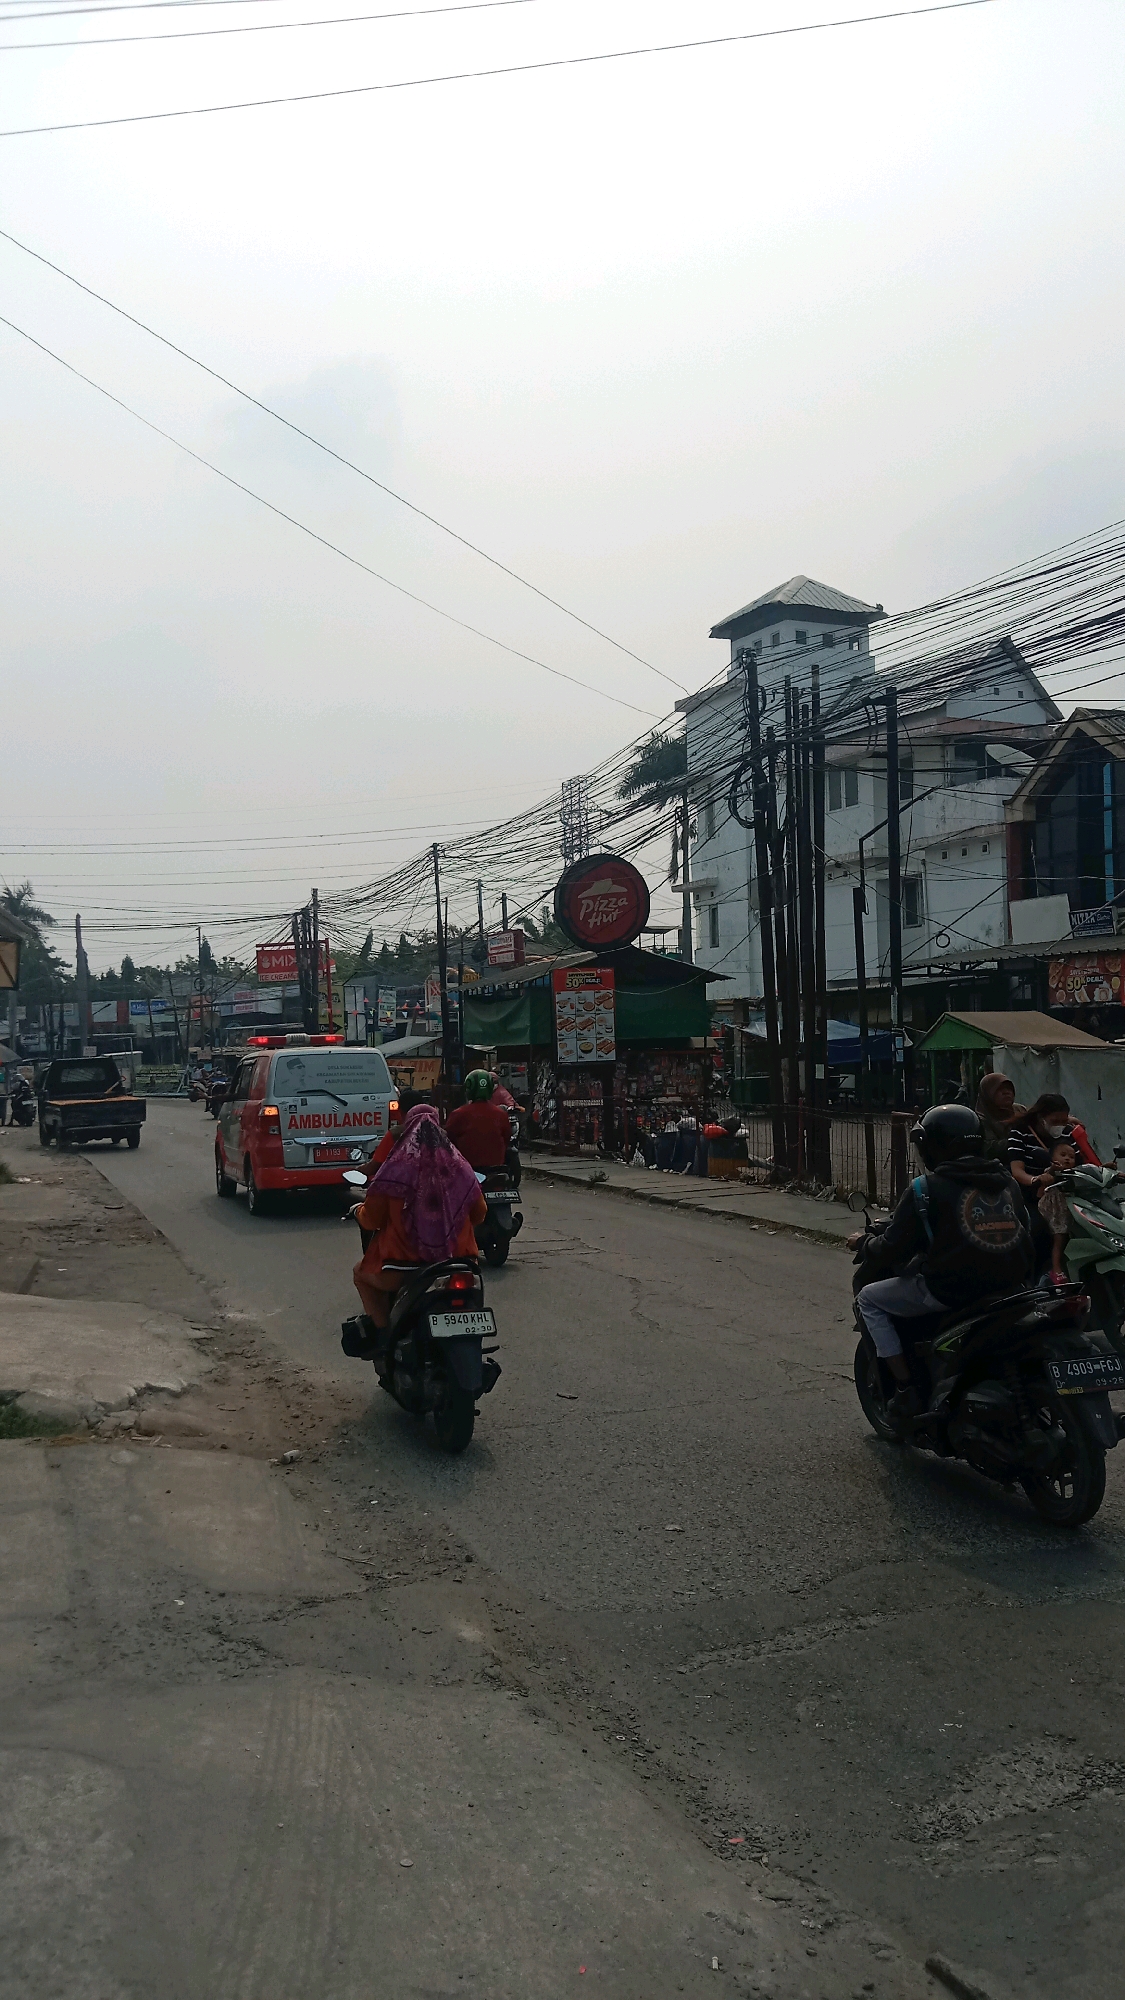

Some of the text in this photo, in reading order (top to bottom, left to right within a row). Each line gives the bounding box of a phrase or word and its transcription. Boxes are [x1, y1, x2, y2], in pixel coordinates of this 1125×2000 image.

[580, 896, 628, 920] Pizza
[588, 909, 623, 929] Hut
[1071, 912, 1096, 925] MITRA
[270, 973, 293, 981] CREAM
[288, 1111, 383, 1130] AMBULANCE
[316, 1149, 321, 1157] B
[325, 1148, 341, 1157] 1193
[432, 1312, 489, 1326] B 5940 KHL
[1052, 1365, 1061, 1378] B
[1067, 1362, 1094, 1376] 4909
